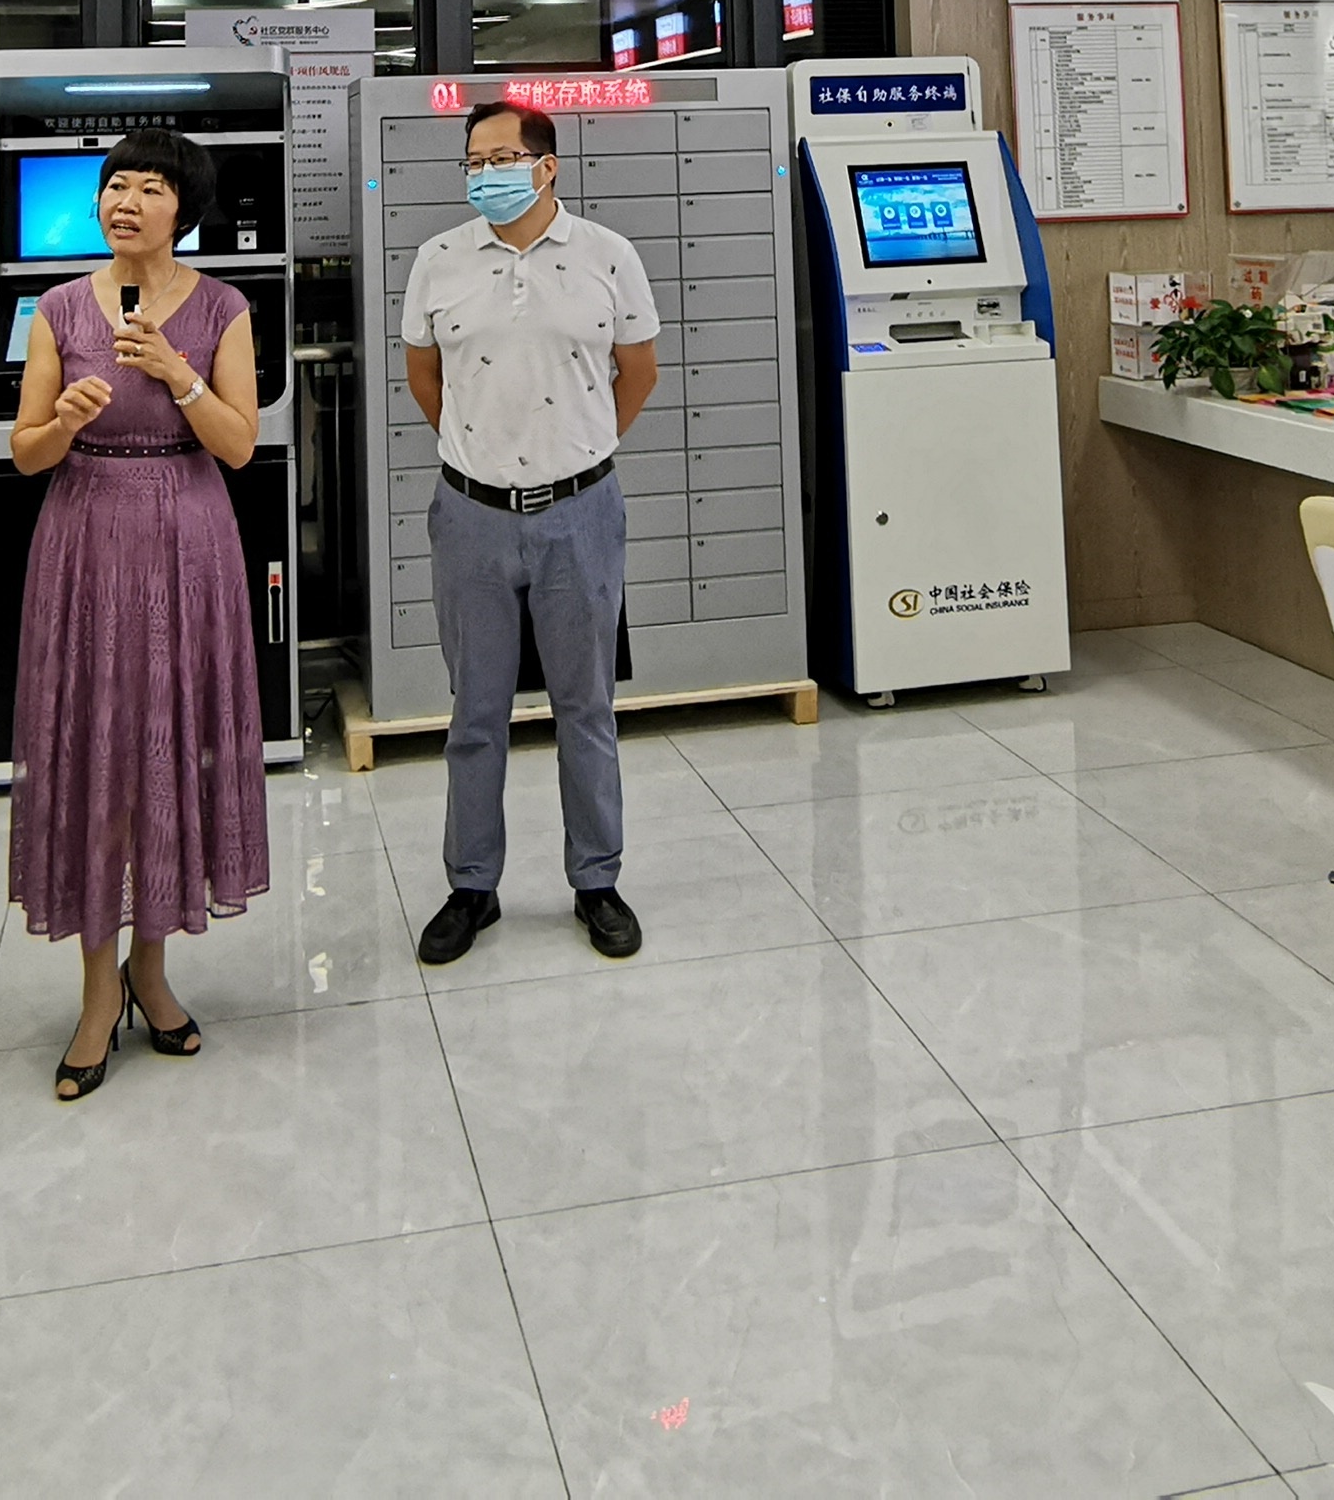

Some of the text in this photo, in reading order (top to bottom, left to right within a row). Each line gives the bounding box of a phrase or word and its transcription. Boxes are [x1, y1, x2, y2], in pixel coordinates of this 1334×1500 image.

[432, 82, 461, 109] 01
[506, 78, 652, 108] 智能存取系统
[818, 84, 958, 104] 社保自助服务终端
[44, 116, 176, 129] 欢迎使用自助服务终端
[929, 579, 1031, 605] 中国社会保险
[929, 598, 1030, 616] CHINA SOCIAL INSURANCE
